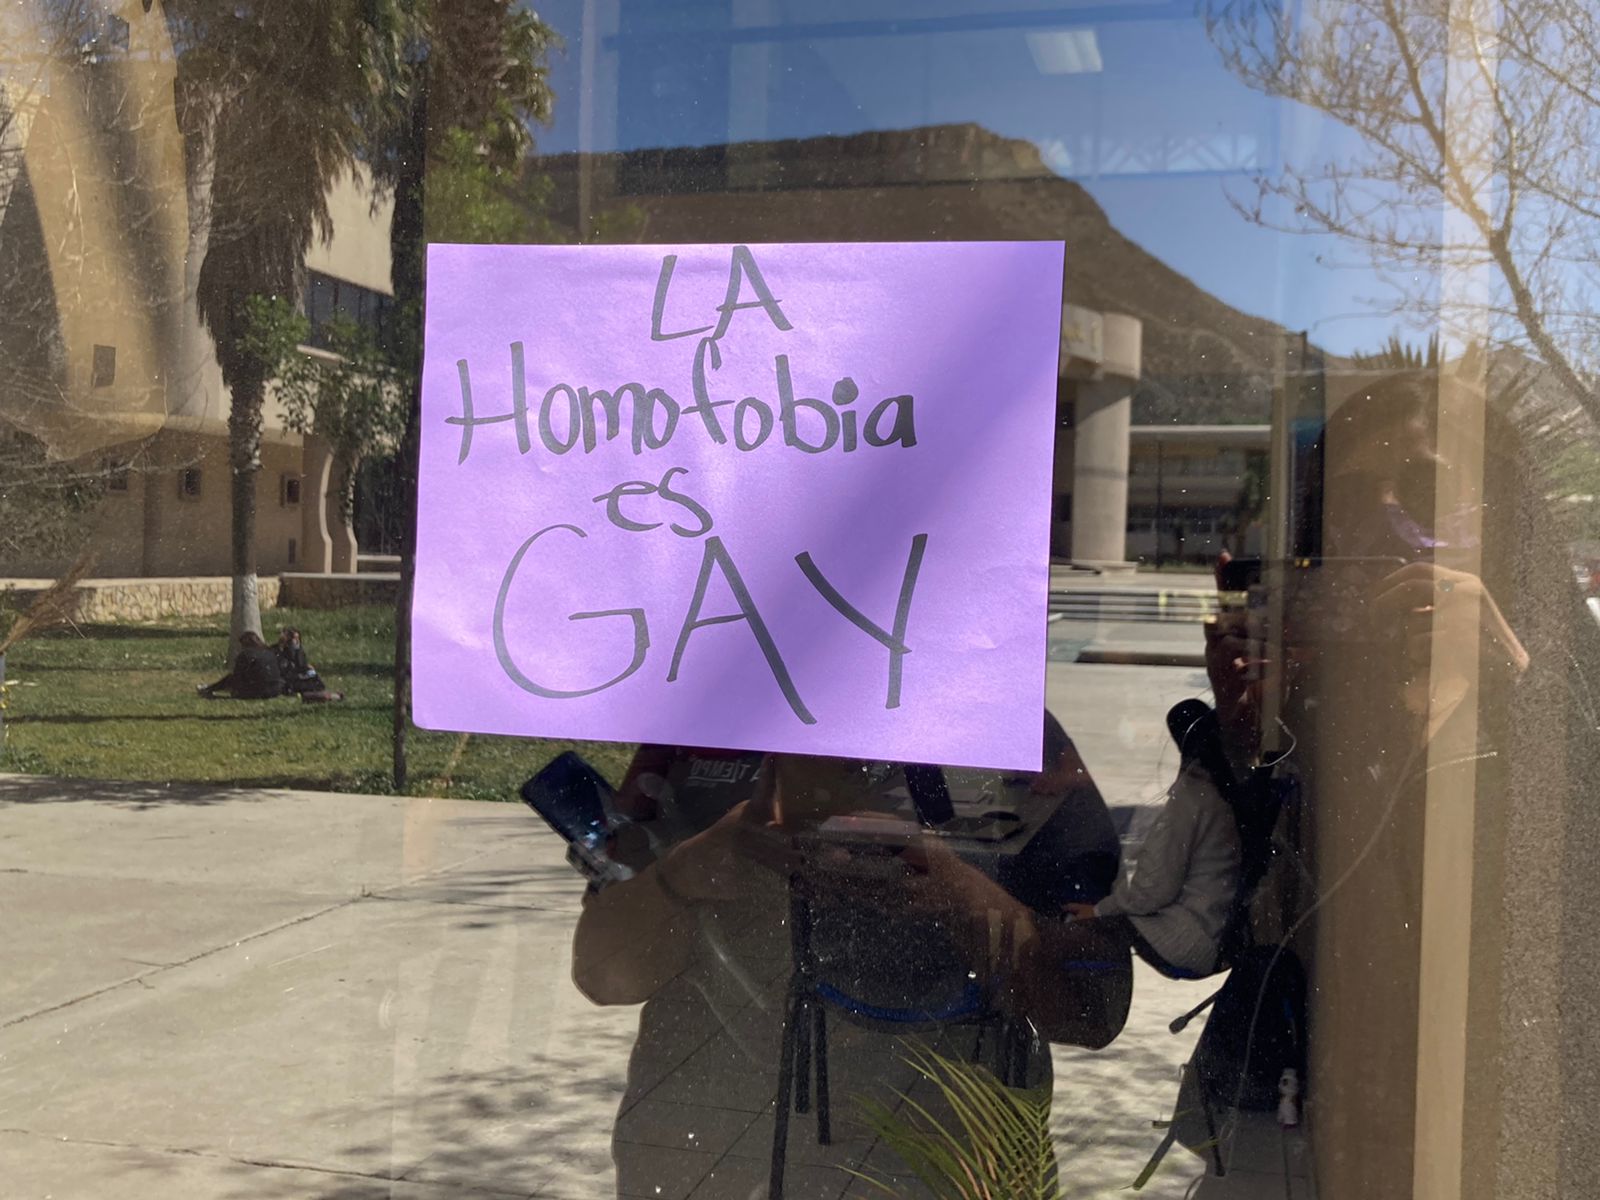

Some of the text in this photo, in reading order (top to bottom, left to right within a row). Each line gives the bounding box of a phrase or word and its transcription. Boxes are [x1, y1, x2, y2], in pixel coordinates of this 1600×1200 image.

[651, 245, 794, 341] LA
[445, 337, 917, 464] Homofobia
[592, 467, 714, 538] es
[493, 523, 929, 725] GAY
